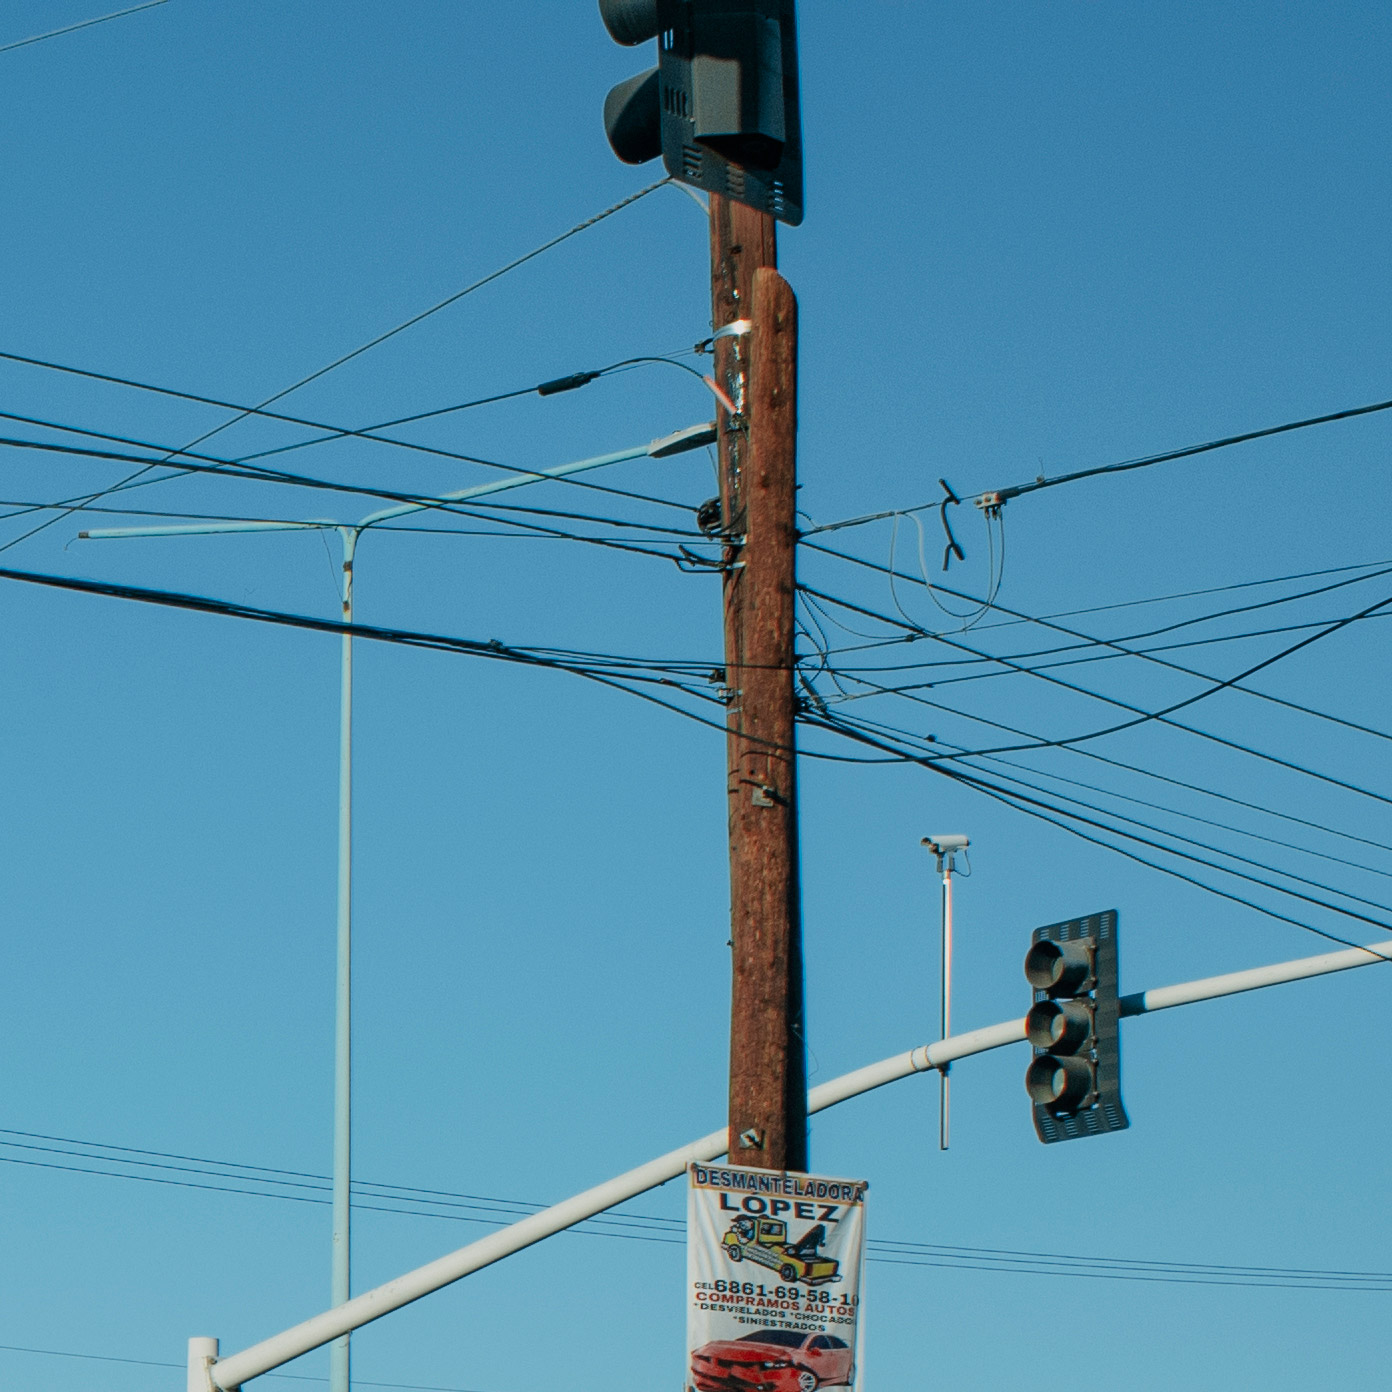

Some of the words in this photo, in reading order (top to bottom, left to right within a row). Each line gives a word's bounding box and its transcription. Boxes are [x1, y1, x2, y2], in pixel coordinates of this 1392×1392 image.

[696, 1168, 864, 1202] DESMANTELADORA
[696, 1291, 800, 1311] COMPRAMOS
[804, 1304, 855, 1317] AUTOS
